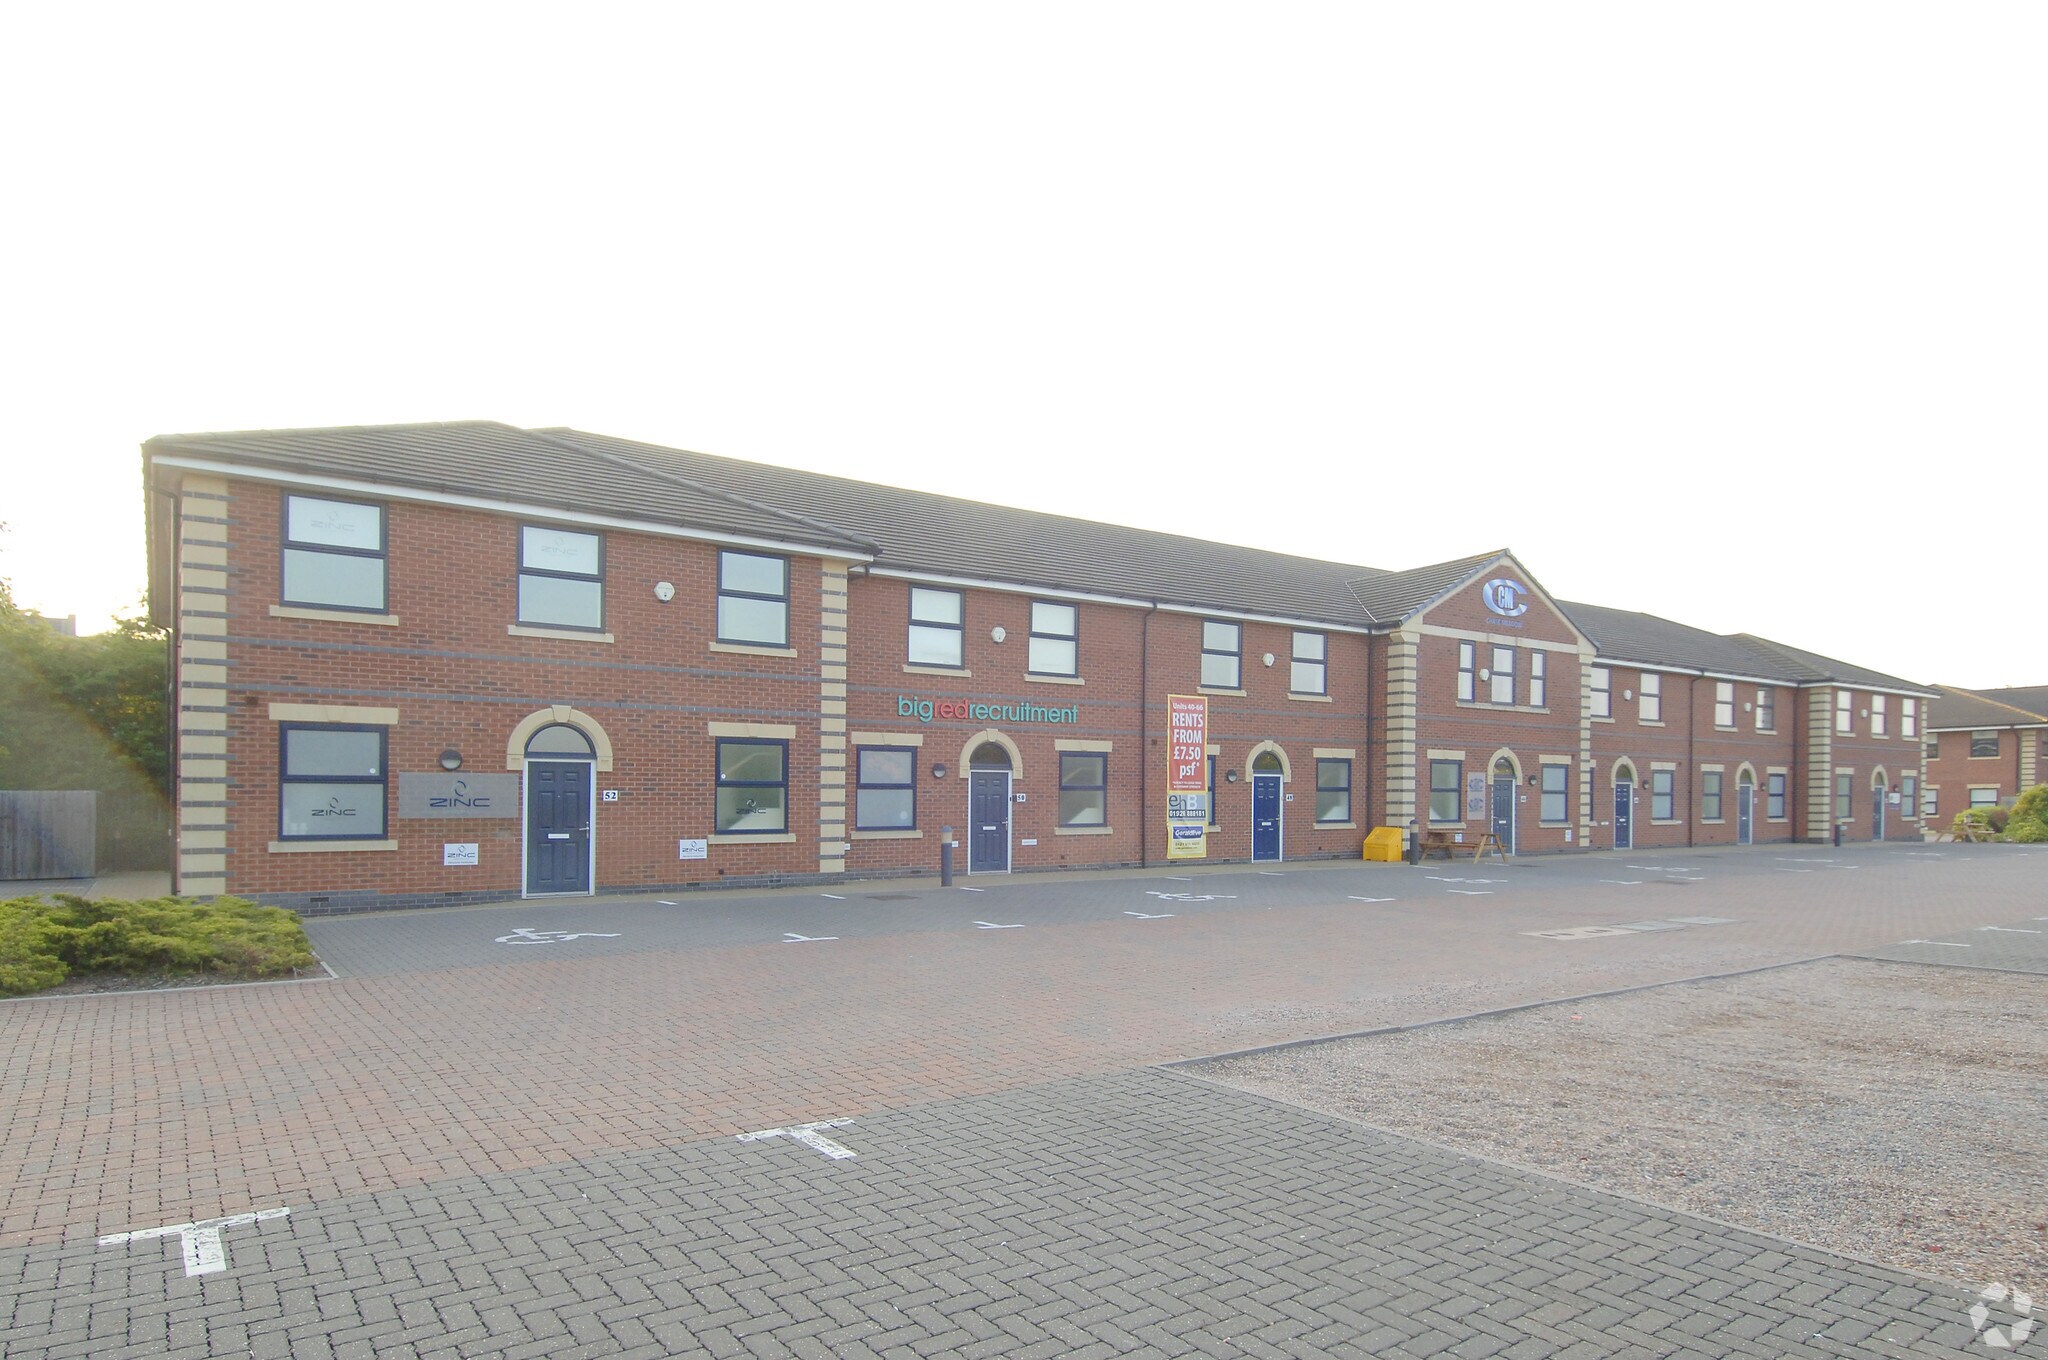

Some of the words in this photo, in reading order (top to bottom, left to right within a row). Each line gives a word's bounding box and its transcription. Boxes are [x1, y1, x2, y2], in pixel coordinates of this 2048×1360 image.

[310, 520, 356, 532] ZINC
[541, 545, 578, 556] ZINC
[1172, 702, 1187, 710] Units
[1172, 712, 1204, 728] RENTS
[1173, 729, 1202, 744] FROM
[1173, 745, 1201, 760] £7.50
[604, 791, 617, 800] 52
[429, 798, 491, 807] ZINC
[311, 808, 357, 817] ZINC
